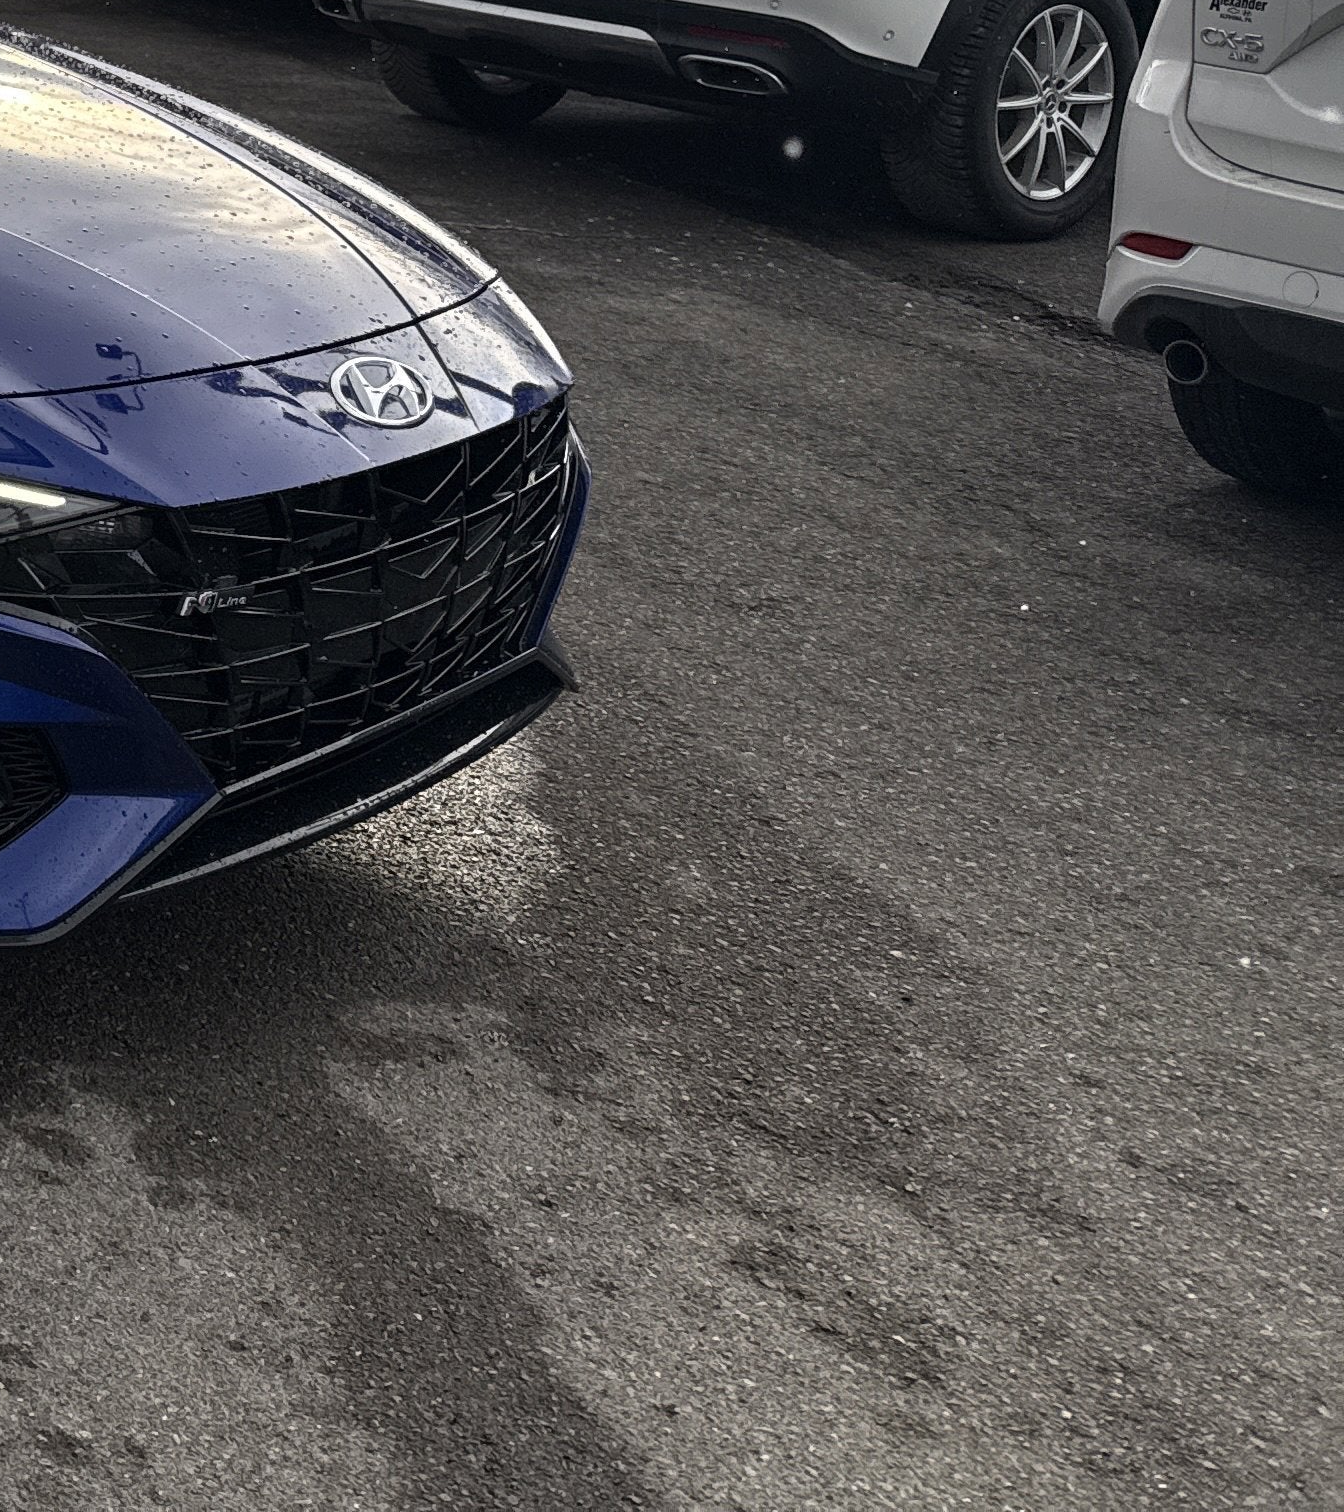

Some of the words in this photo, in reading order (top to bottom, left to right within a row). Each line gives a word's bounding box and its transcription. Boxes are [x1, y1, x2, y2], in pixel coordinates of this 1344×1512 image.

[1200, 26, 1265, 53] CX-5
[1227, 50, 1259, 64] AWD
[216, 596, 248, 608] Line
